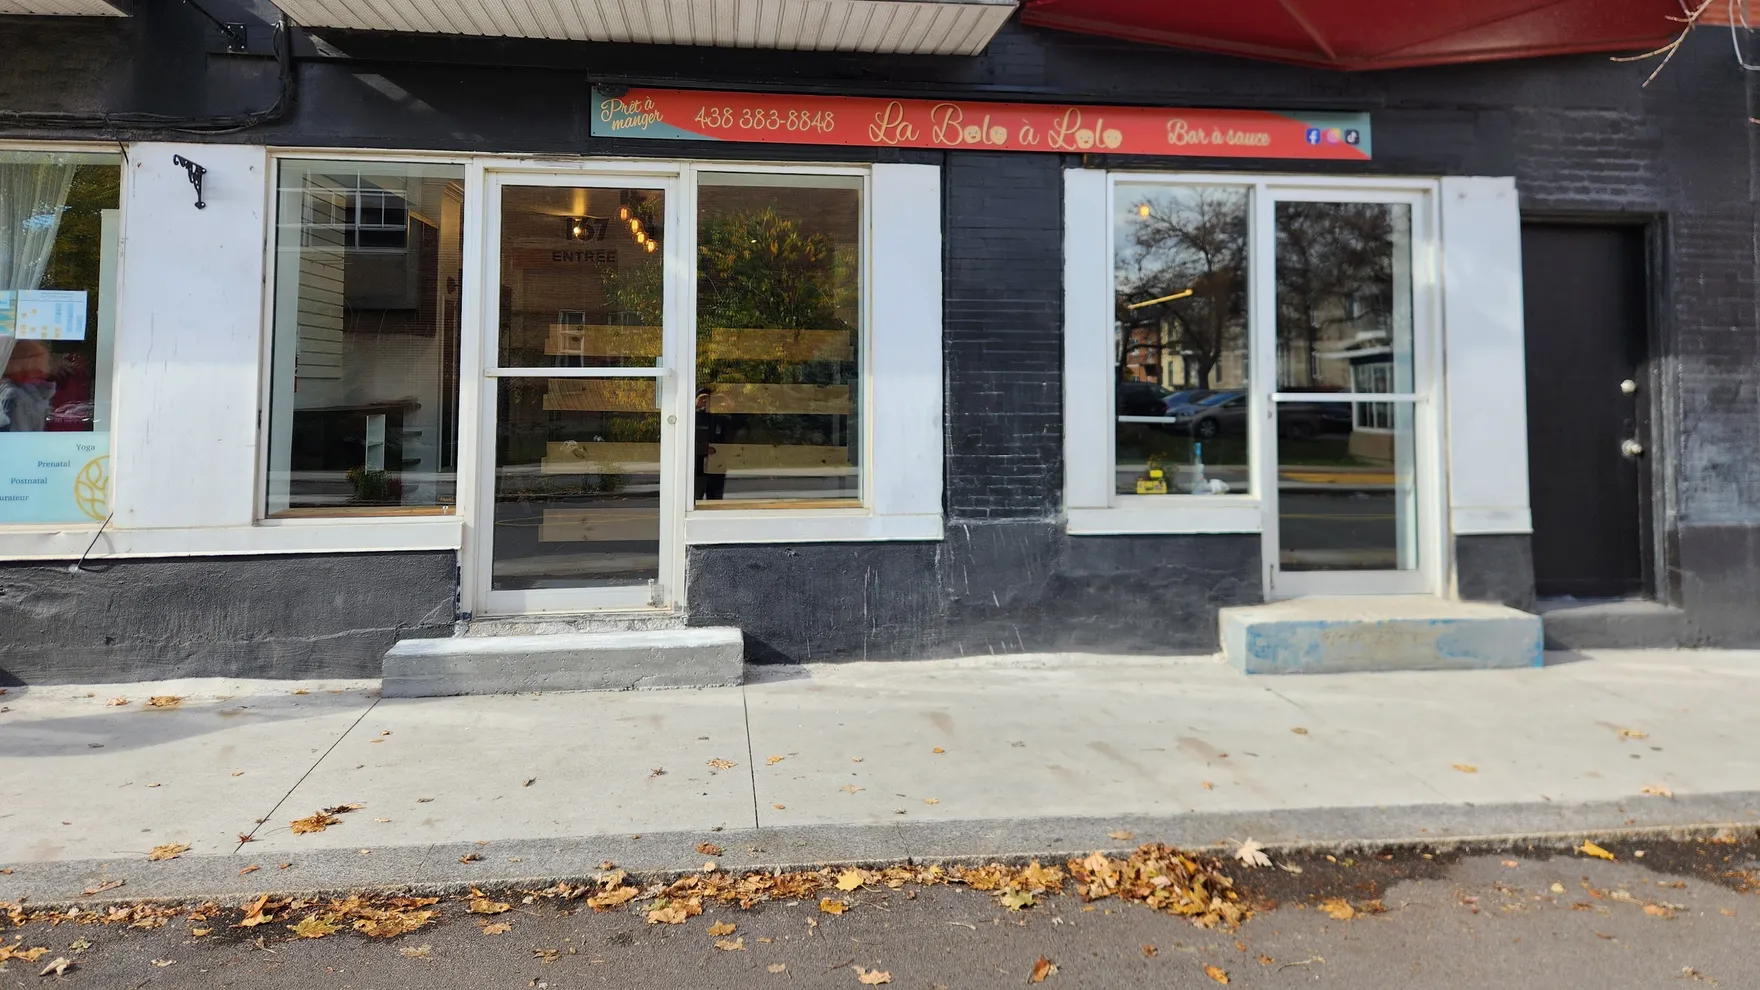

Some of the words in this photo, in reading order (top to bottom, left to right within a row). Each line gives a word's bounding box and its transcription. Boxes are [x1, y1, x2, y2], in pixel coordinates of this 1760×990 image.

[601, 99, 642, 122] Prêt
[644, 96, 655, 110] à
[611, 110, 664, 131] manger
[695, 106, 733, 129] 438
[739, 108, 835, 133] 383-8848
[868, 100, 919, 145] La
[930, 103, 1008, 146] Bolo
[1018, 118, 1040, 146] à
[1047, 107, 1123, 151] Lolo
[1166, 118, 1210, 146] Bar
[1211, 126, 1223, 145] à
[1226, 130, 1270, 147] sauce
[76, 444, 96, 452] Yoga
[37, 460, 71, 468] Prenatal
[10, 477, 48, 485] Postnatal
